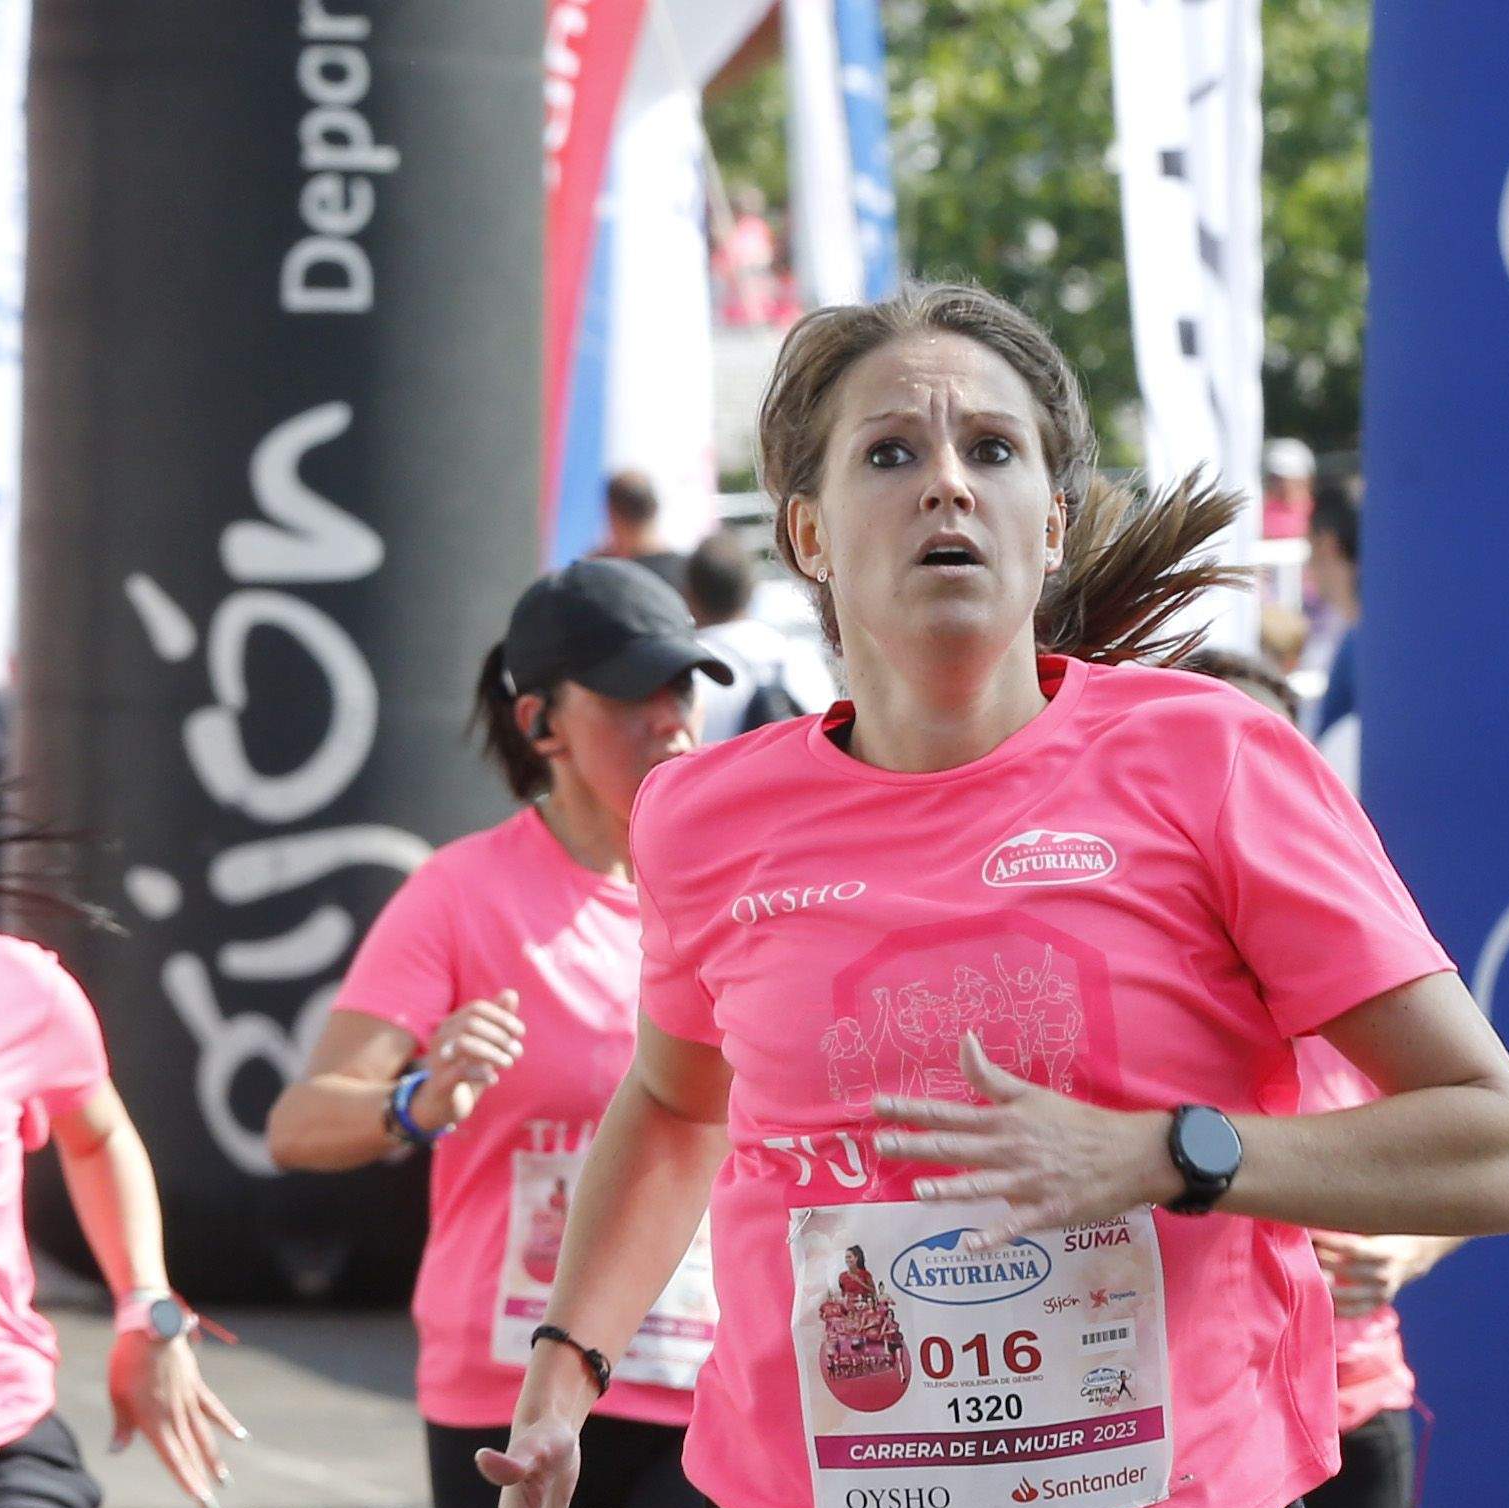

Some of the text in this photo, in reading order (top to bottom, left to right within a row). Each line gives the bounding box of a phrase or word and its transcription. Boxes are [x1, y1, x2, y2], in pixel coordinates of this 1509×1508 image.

[992, 853, 1106, 881] ASTURIANA
[731, 880, 867, 925] OYSHO
[1079, 1215, 1130, 1231] DORSAL
[1064, 1227, 1131, 1252] SUMA
[904, 1257, 1042, 1288] ASTURIANA
[919, 1330, 1042, 1380] 016
[947, 1393, 1023, 1424] 1320
[850, 1419, 1138, 1461] CARRERA DE LA MUJER 2023
[1042, 1466, 1148, 1500] Santander
